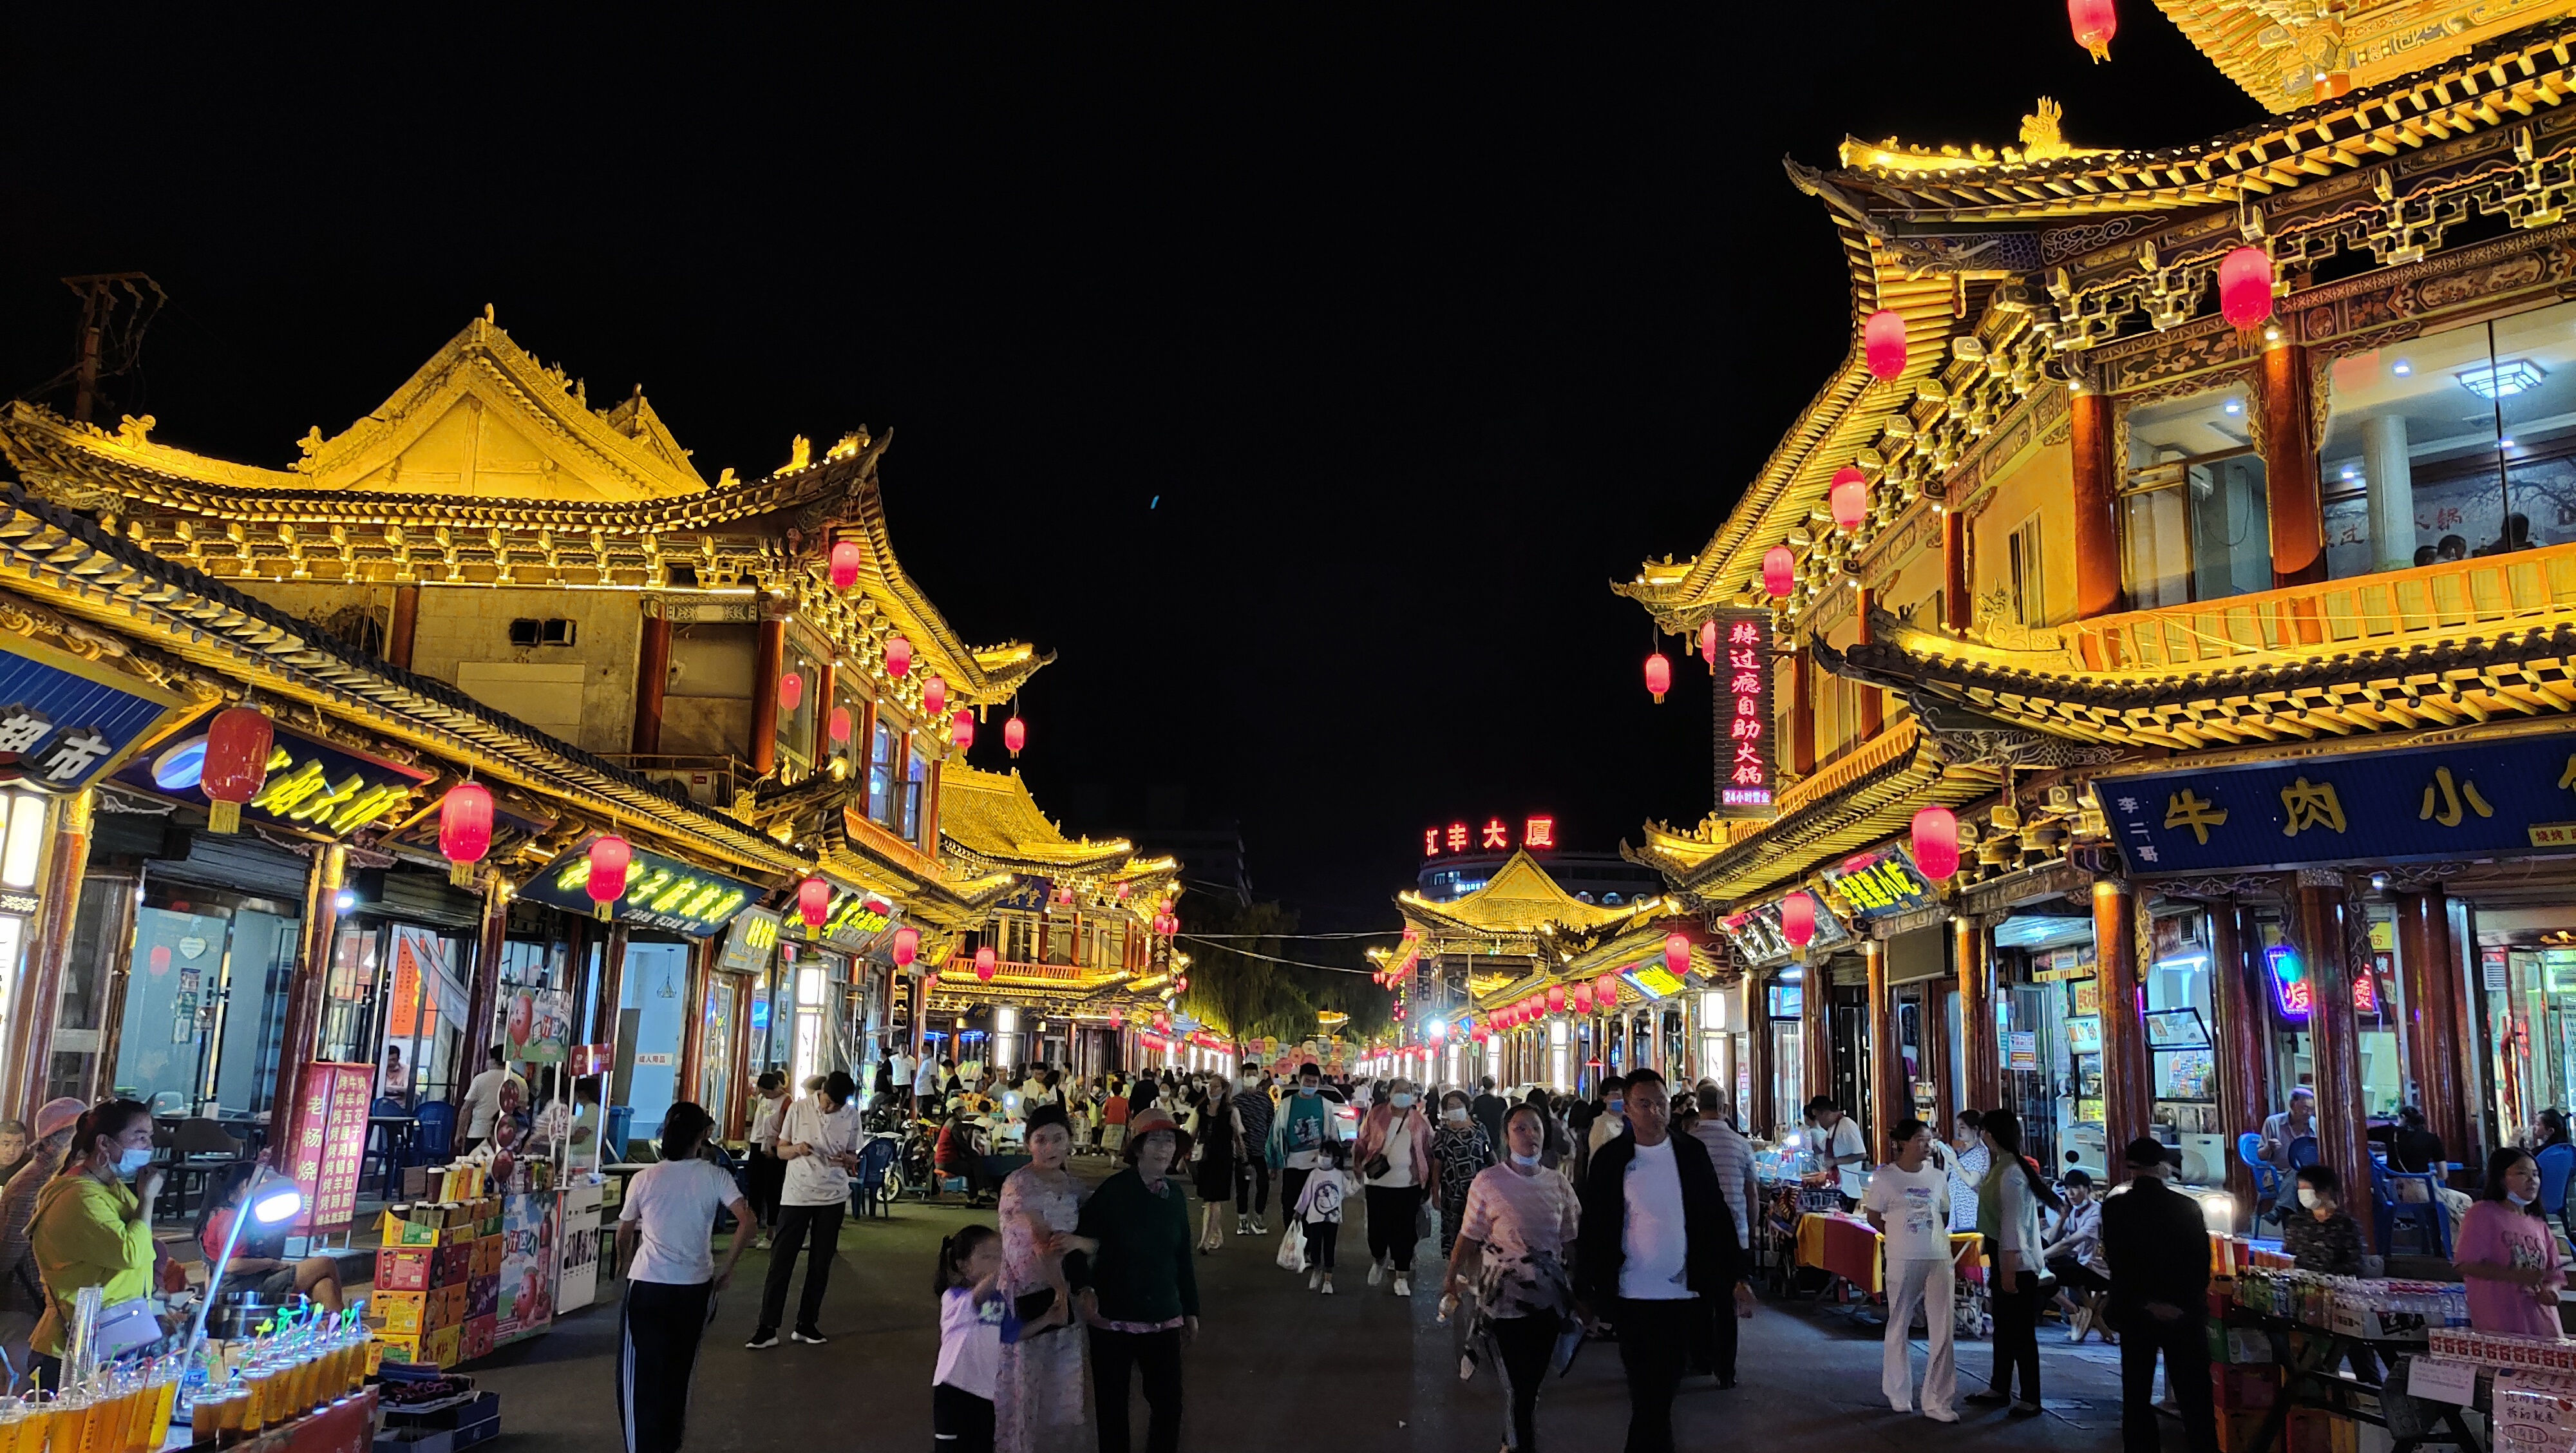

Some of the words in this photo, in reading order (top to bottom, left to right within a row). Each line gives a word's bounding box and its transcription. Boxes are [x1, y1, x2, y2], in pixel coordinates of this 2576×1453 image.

[1728, 623, 1763, 784] 辣过瘾自助火锅
[251, 751, 409, 835] 烟大师
[1724, 791, 1770, 804] 24小时营业
[2117, 797, 2159, 862] 李二哥
[1426, 819, 1553, 857] 汇丰大厦
[638, 1055, 666, 1063] 成人用品
[337, 1074, 366, 1090] 烤牛肉
[334, 1092, 366, 1107] 烤羊肉
[332, 1108, 364, 1123] 烤五花
[330, 1125, 362, 1141] 烤腰子
[327, 1142, 359, 1159] 烤鸡翅
[321, 1175, 354, 1193] 烤羊肚
